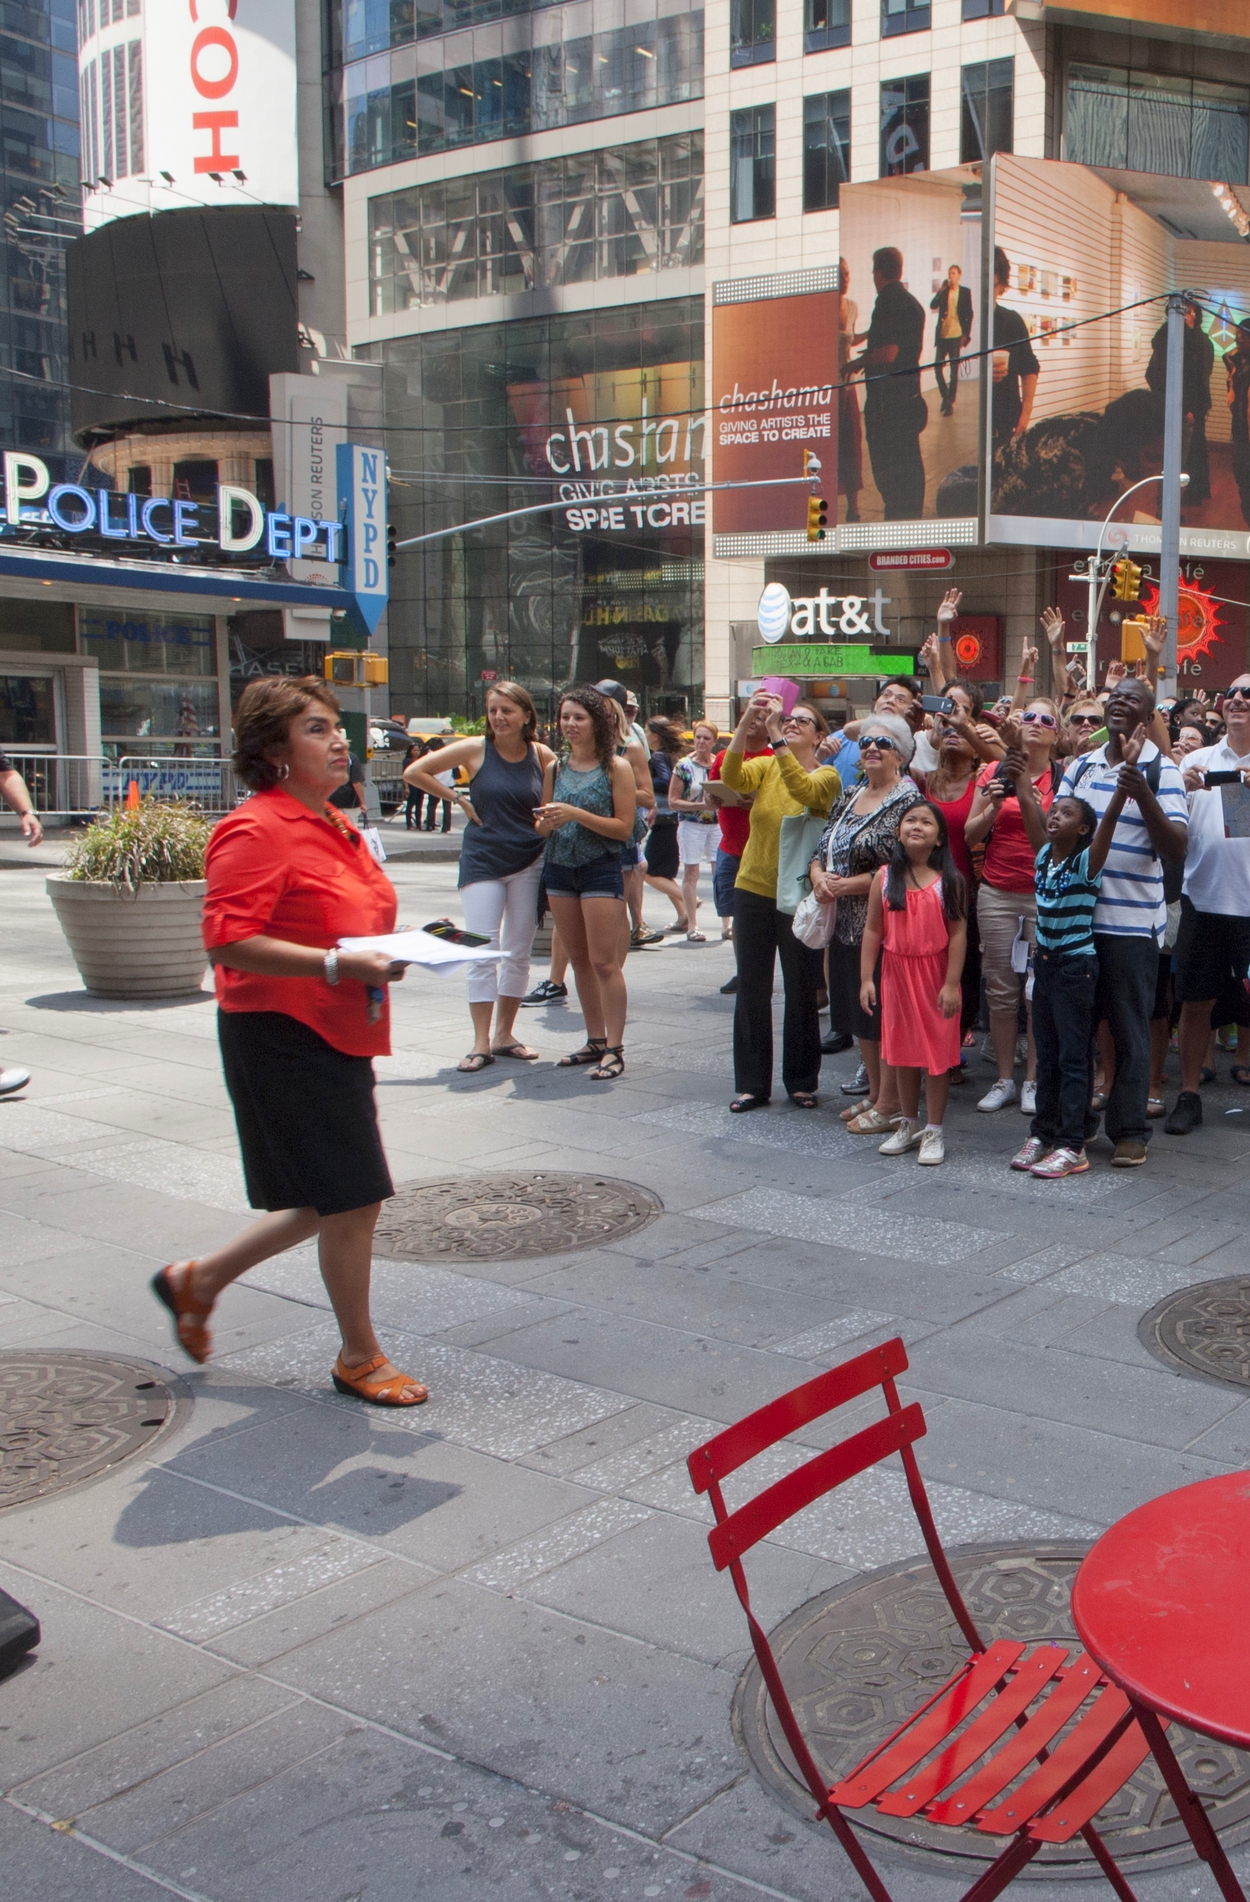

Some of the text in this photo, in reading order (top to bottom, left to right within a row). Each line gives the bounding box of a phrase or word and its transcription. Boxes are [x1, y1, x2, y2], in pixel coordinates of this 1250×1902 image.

[720, 379, 832, 414] chashama
[720, 413, 831, 434] GIVING ARTISTS THE
[719, 426, 831, 446] SPACE TO CREATE
[310, 416, 324, 485] REUTERS
[361, 452, 379, 589] NYPD
[1190, 538, 1237, 549] REUTERS
[876, 554, 945, 566] BRANDED CITIES.com
[790, 587, 892, 636] at&t
[106, 620, 191, 646] POLICE
[229, 662, 300, 682] HASE
[126, 772, 189, 791] NYPD
